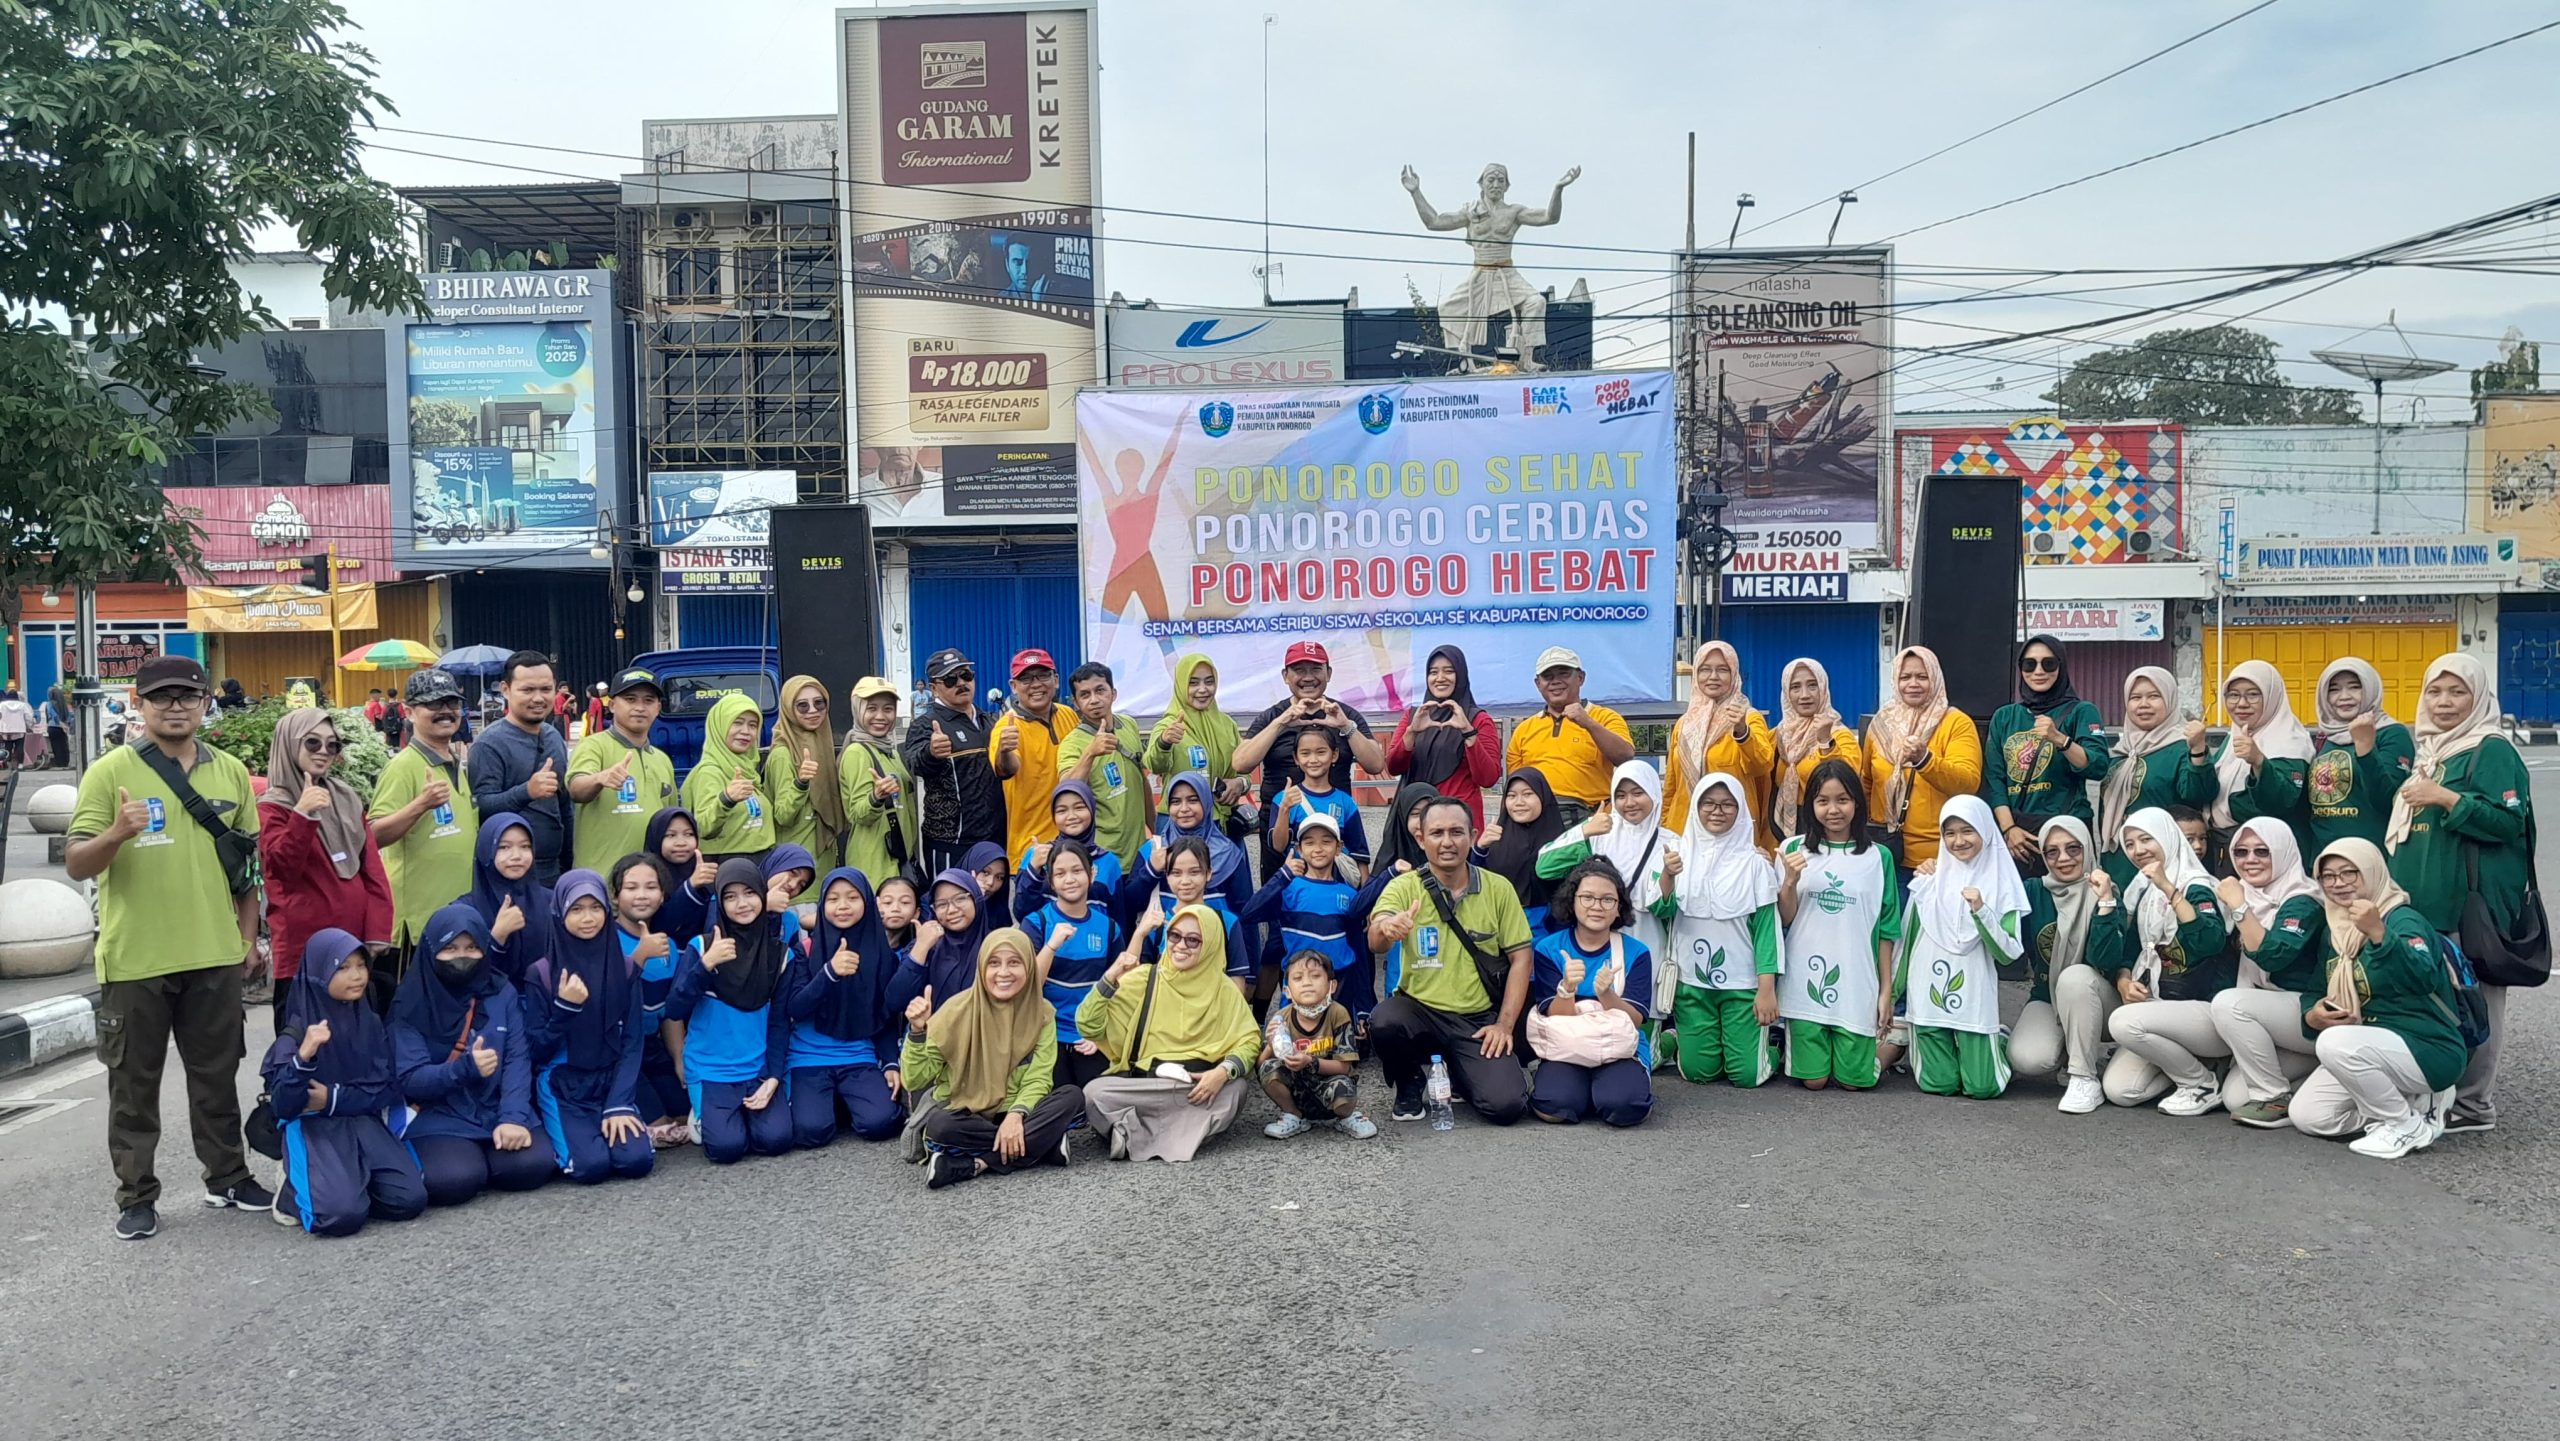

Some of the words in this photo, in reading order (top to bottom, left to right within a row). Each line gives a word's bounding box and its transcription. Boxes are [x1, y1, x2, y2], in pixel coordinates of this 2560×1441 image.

[1035, 24, 1061, 167] KRETEK
[920, 99, 989, 115] GUDANG
[897, 113, 1014, 141] GARAM
[898, 148, 1013, 169] International
[862, 232, 886, 243] 2020's
[928, 221, 961, 234] 2010's
[1021, 211, 1068, 226] 1990's
[1055, 237, 1089, 255] PRIA
[1055, 253, 1090, 268] PUNYA
[1055, 264, 1091, 280] SELERA
[437, 276, 550, 300] BHIRAWA
[554, 275, 592, 297] G.R
[1749, 277, 1811, 291] natasha
[471, 303, 536, 316] Consultant
[539, 303, 584, 314] Interior
[1707, 301, 1822, 331] CLEANSING
[1829, 301, 1862, 327] OIL
[913, 341, 955, 352] BARU
[1730, 335, 1778, 345] WASHABLE
[1780, 335, 1795, 343] OIL
[1798, 333, 1859, 342] TECHNOLOGY
[422, 345, 452, 357] Miliki
[454, 346, 495, 357] Rumah
[497, 345, 525, 356] Baru
[545, 352, 577, 363] 2025
[1743, 352, 1762, 360] Deep
[1764, 351, 1798, 360] Cleansing
[422, 359, 466, 370] Liburan
[468, 359, 534, 370] menantimu
[1122, 360, 1334, 386] PROLEXUS
[1532, 387, 1557, 396] CAR
[1595, 379, 1629, 395] PONO
[919, 398, 953, 410] RASA
[957, 397, 1040, 410] LEGENDARIS
[1400, 398, 1425, 409] DINAS
[1427, 394, 1479, 408] PENDIDIKAN
[1532, 395, 1558, 405] FREE
[1597, 389, 1630, 406] ROGO
[1607, 391, 1660, 415] HEBAT
[934, 412, 975, 423] TANPA
[980, 411, 1020, 423] FILTER
[1237, 412, 1264, 421] PEMUDA
[1265, 411, 1280, 420] DAN
[1280, 410, 1315, 419] OLAHRAGA
[1400, 410, 1450, 423] KABUPATEN
[1452, 407, 1498, 420] PONOROGO
[1532, 405, 1557, 416] DAY
[1237, 422, 1275, 431] KABUPATEN
[1276, 421, 1312, 430] PONOROGO
[444, 458, 472, 471] 15%
[997, 453, 1050, 461] PERINGATAN:
[1195, 458, 1460, 504] PONOROGO
[1486, 451, 1644, 493] SEHAT
[524, 492, 556, 502] Booking
[557, 490, 596, 501] Sekarang!
[1195, 505, 1447, 555] PONOROGO
[1465, 499, 1650, 545] CERDAS
[1952, 527, 1992, 537] DEVIS
[1765, 530, 1842, 548] 150500
[665, 549, 726, 568] ISTANA
[802, 557, 842, 567] DEVIS
[1733, 551, 1839, 572] MURAH
[2258, 549, 2296, 569] PUSAT
[2300, 547, 2374, 568] PENUKARAN
[2378, 546, 2412, 567] MATA
[2415, 546, 2446, 566] UANG
[2451, 545, 2489, 566] ASING
[204, 561, 247, 573] Rasanya
[249, 559, 275, 571] Bikin
[276, 560, 289, 573] ga
[682, 572, 720, 585] GROSIR
[729, 571, 762, 584] RETAIL
[1190, 552, 1469, 608] PONOROGO
[1490, 547, 1657, 594] HEBAT
[1732, 575, 1839, 597] MERIAH
[2249, 608, 2287, 616] PUSAT
[2288, 607, 2362, 615] PENUKARAN
[2363, 606, 2398, 614] UANG
[1143, 620, 1194, 637] SENAM
[1197, 618, 1266, 635] BERSAMA
[1269, 615, 1322, 633] SERIBU
[1325, 613, 1372, 630] SISWA
[1375, 611, 1444, 628] SEKOLAH
[1447, 609, 1466, 625] SE
[1469, 607, 1559, 624] KABUPATEN
[1561, 604, 1648, 622] PONOROGO
